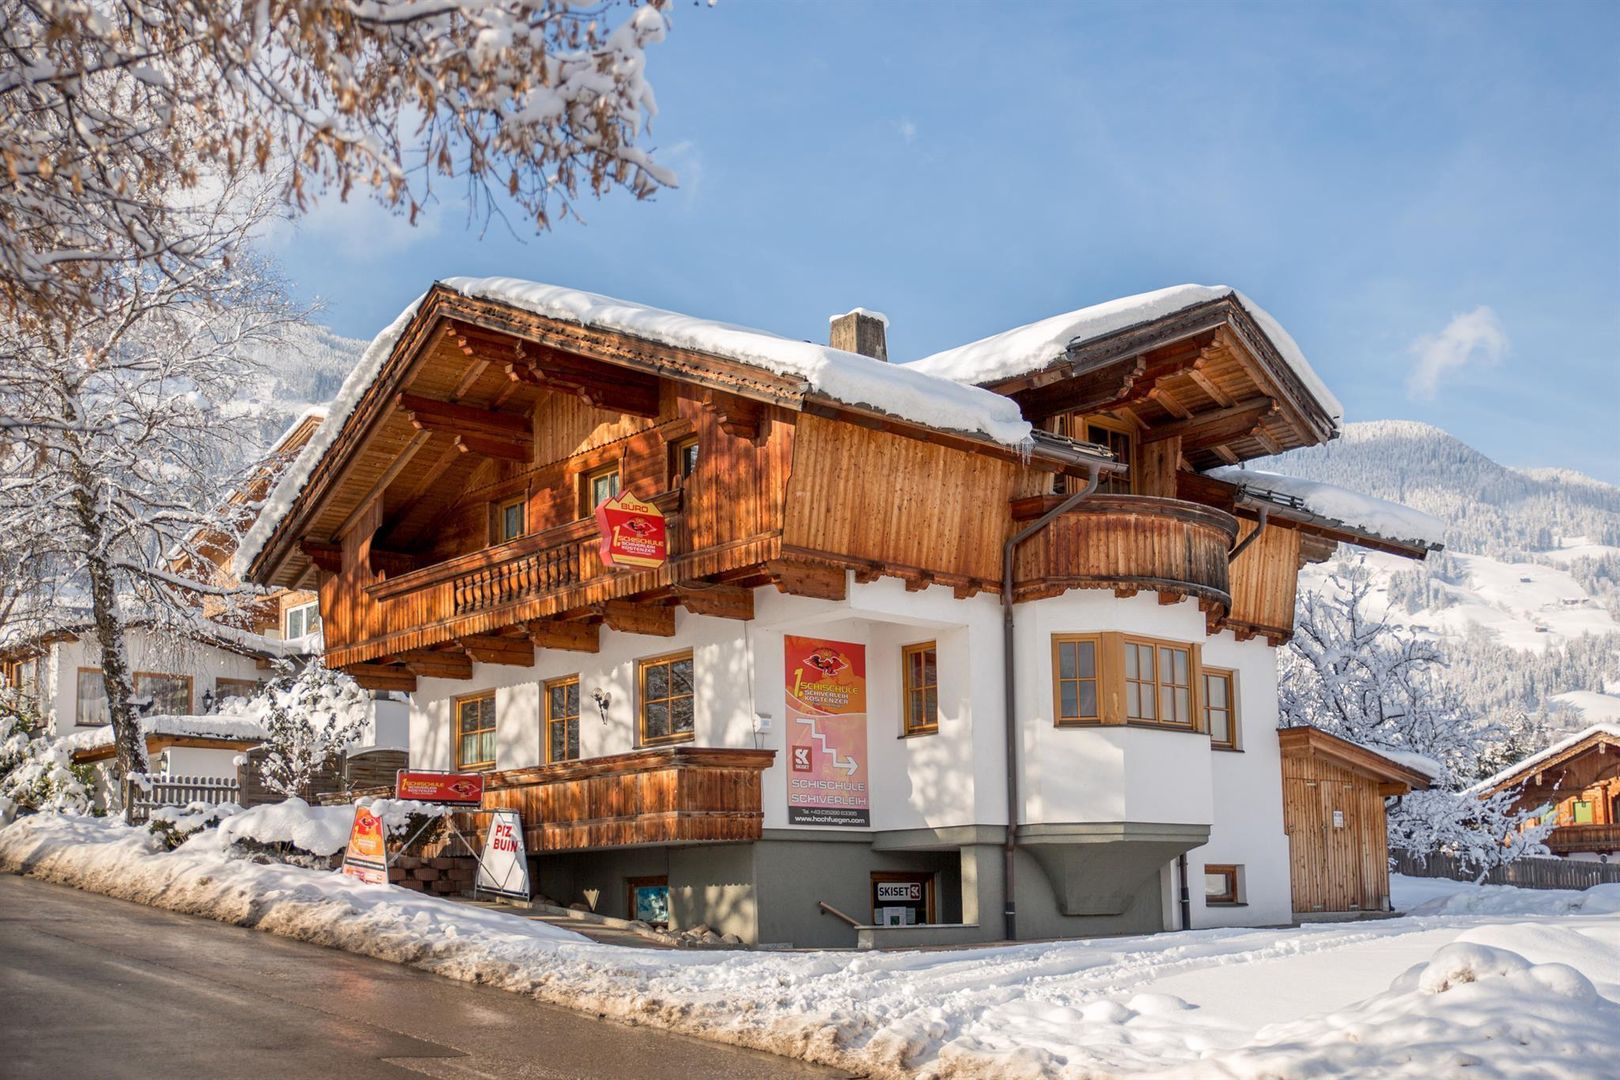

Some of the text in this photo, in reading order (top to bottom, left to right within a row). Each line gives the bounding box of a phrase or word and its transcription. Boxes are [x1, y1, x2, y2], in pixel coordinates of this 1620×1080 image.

[621, 501, 649, 513] BÜRO
[800, 681, 859, 694] SCHISCHULE
[804, 690, 849, 699] SCHIVERLEIH
[804, 695, 848, 705] KOSTENZER
[791, 779, 865, 792] SCHISCHULE
[791, 793, 867, 806] SCHIVERLEIH
[794, 815, 866, 825] www.hochfuegen.com
[496, 824, 512, 838] PIZ
[493, 838, 518, 853] BUIN
[879, 886, 909, 897] SKISET
